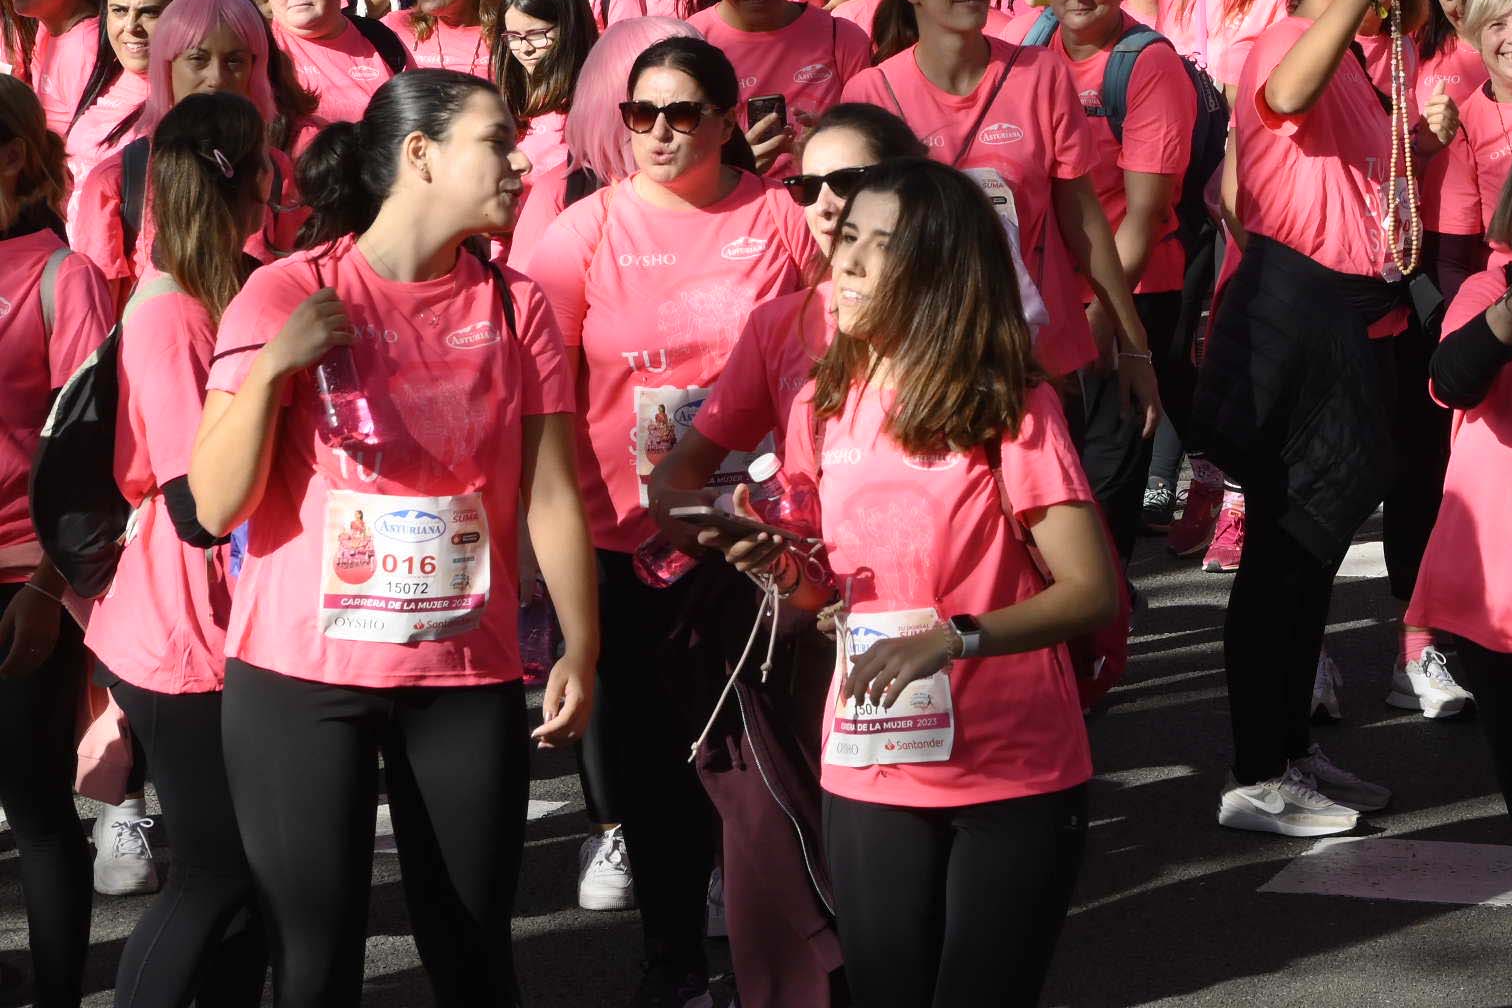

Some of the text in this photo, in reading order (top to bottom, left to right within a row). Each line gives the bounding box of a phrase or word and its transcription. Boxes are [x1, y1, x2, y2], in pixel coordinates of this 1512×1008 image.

[983, 130, 1021, 143] ASTURIANA
[982, 182, 1005, 190] SUMA
[619, 250, 677, 267] OYSHO
[620, 348, 669, 374] TU
[332, 447, 384, 482] TU
[452, 512, 479, 523] SUMA
[380, 518, 442, 535] ASTURIANA
[382, 553, 437, 575] 016
[386, 581, 429, 595] 15072
[340, 597, 472, 610] CARRERA DE LA MUJER 2023
[334, 616, 386, 632] OYSHO
[869, 720, 881, 731] LA
[882, 719, 914, 730] MUJER
[917, 717, 938, 727] 2023
[896, 737, 945, 751] Santander
